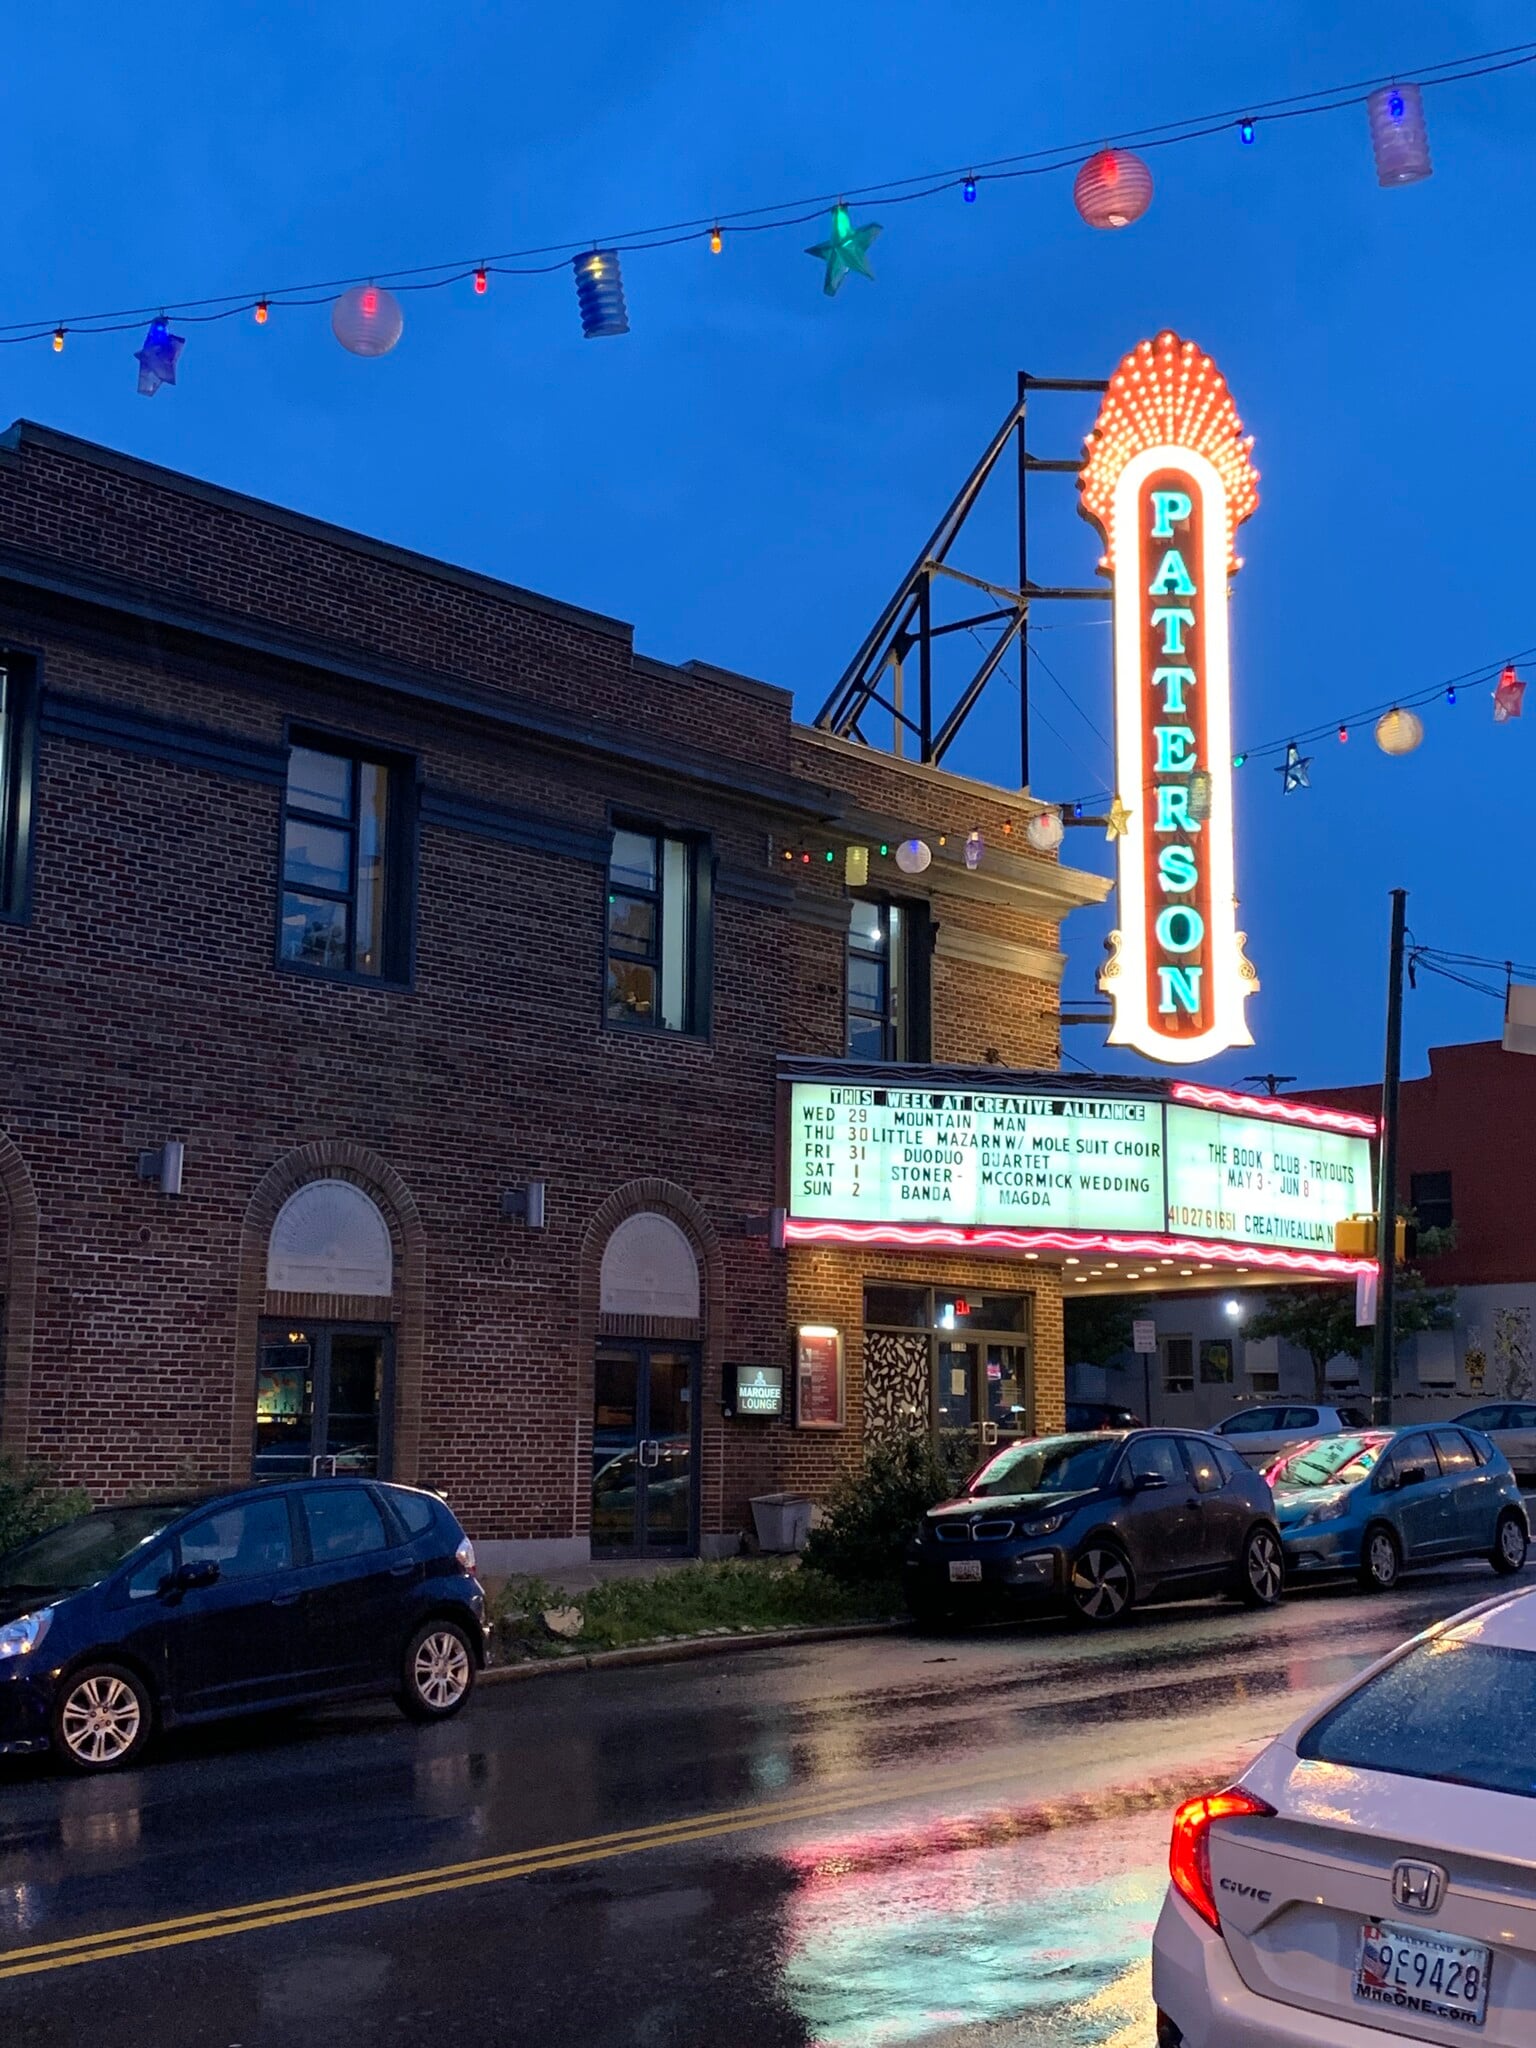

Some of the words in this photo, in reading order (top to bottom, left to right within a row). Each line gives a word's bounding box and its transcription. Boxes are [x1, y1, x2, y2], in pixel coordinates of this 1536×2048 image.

[1149, 491, 1205, 1014] PATTERSON
[803, 1106, 835, 1122] WED
[848, 1109, 867, 1123] 29
[894, 1111, 972, 1129] MOUNTAIN
[993, 1117, 1026, 1132] MAN
[830, 1089, 872, 1105] THIS
[888, 1091, 932, 1109] WEEK
[942, 1095, 963, 1110] AT
[974, 1096, 1054, 1115] CREATIVE
[1062, 1102, 1145, 1121] ALLIANCE
[804, 1125, 834, 1140] THU
[848, 1127, 868, 1142] 30
[872, 1128, 923, 1145] LITTLE
[1032, 1137, 1070, 1153] MOLE
[1076, 1139, 1109, 1154] SUIT
[1114, 1141, 1161, 1158] CHOIR
[805, 1143, 831, 1159] FRI
[849, 1145, 866, 1160] 31
[904, 1148, 963, 1165] DUODUO
[982, 1152, 1050, 1169] QUARTET
[1208, 1143, 1227, 1164] THE
[1233, 1148, 1263, 1169] BOOK
[1273, 1153, 1300, 1175] CLUB
[805, 1162, 835, 1178] SAT
[855, 1164, 859, 1179] 1
[982, 1171, 1073, 1189] MCCORMICK
[1080, 1175, 1150, 1193] WEDDING
[1227, 1168, 1252, 1189] MAY
[1280, 1176, 1299, 1197] JUN
[1304, 1181, 1310, 1198] 8
[804, 1180, 832, 1197] SUN
[852, 1183, 860, 1198] 2
[901, 1185, 952, 1202] BANDA
[1000, 1189, 1051, 1206] MAGDA
[739, 1387, 782, 1398] MARQUEE
[742, 1398, 778, 1410] LOUNGE
